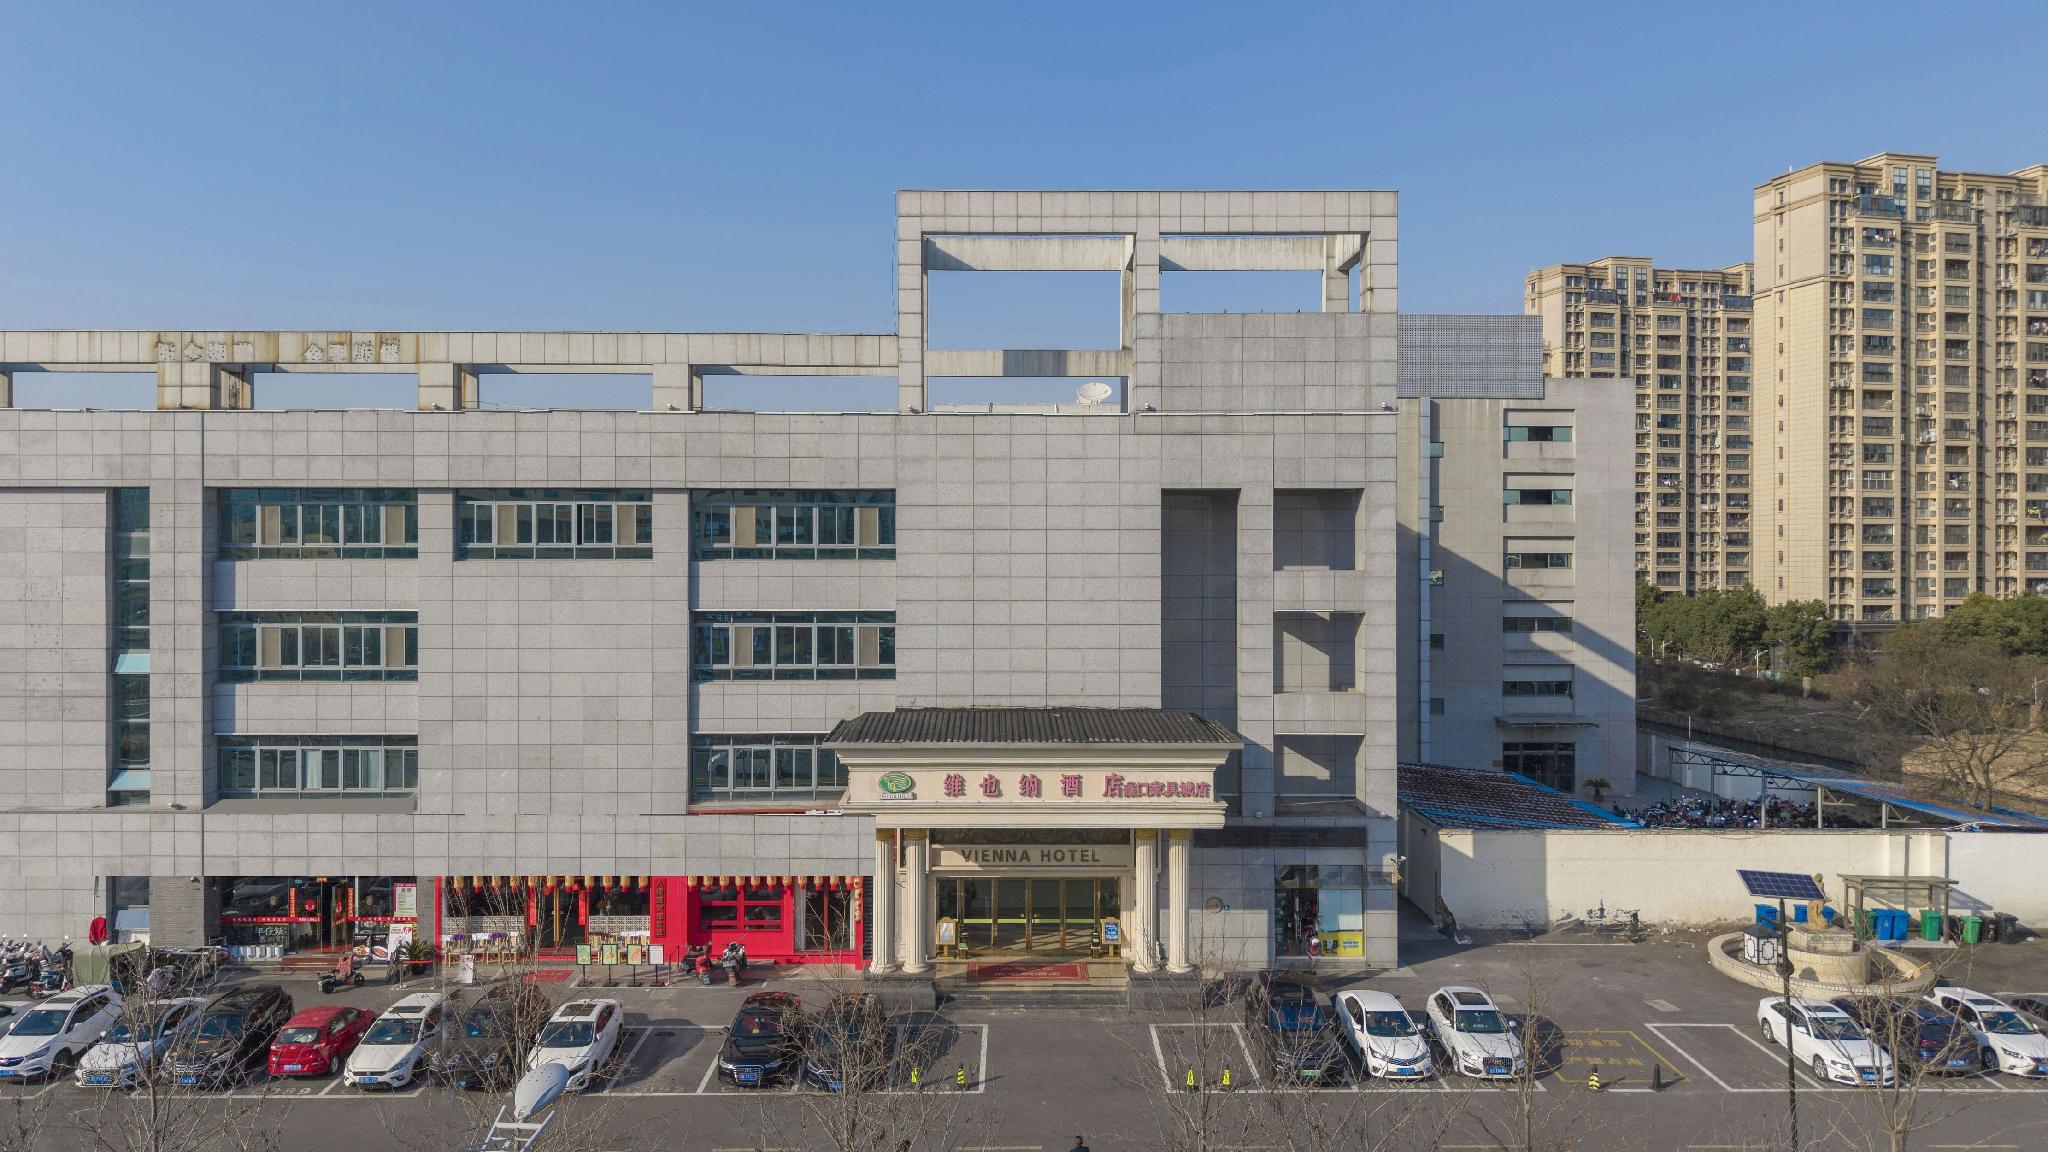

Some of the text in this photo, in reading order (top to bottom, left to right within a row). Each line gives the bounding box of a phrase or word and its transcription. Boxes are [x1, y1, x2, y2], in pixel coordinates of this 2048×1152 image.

[943, 773, 1122, 798] 维也纳酒店
[962, 850, 1099, 862] VIENNA HOTEL
